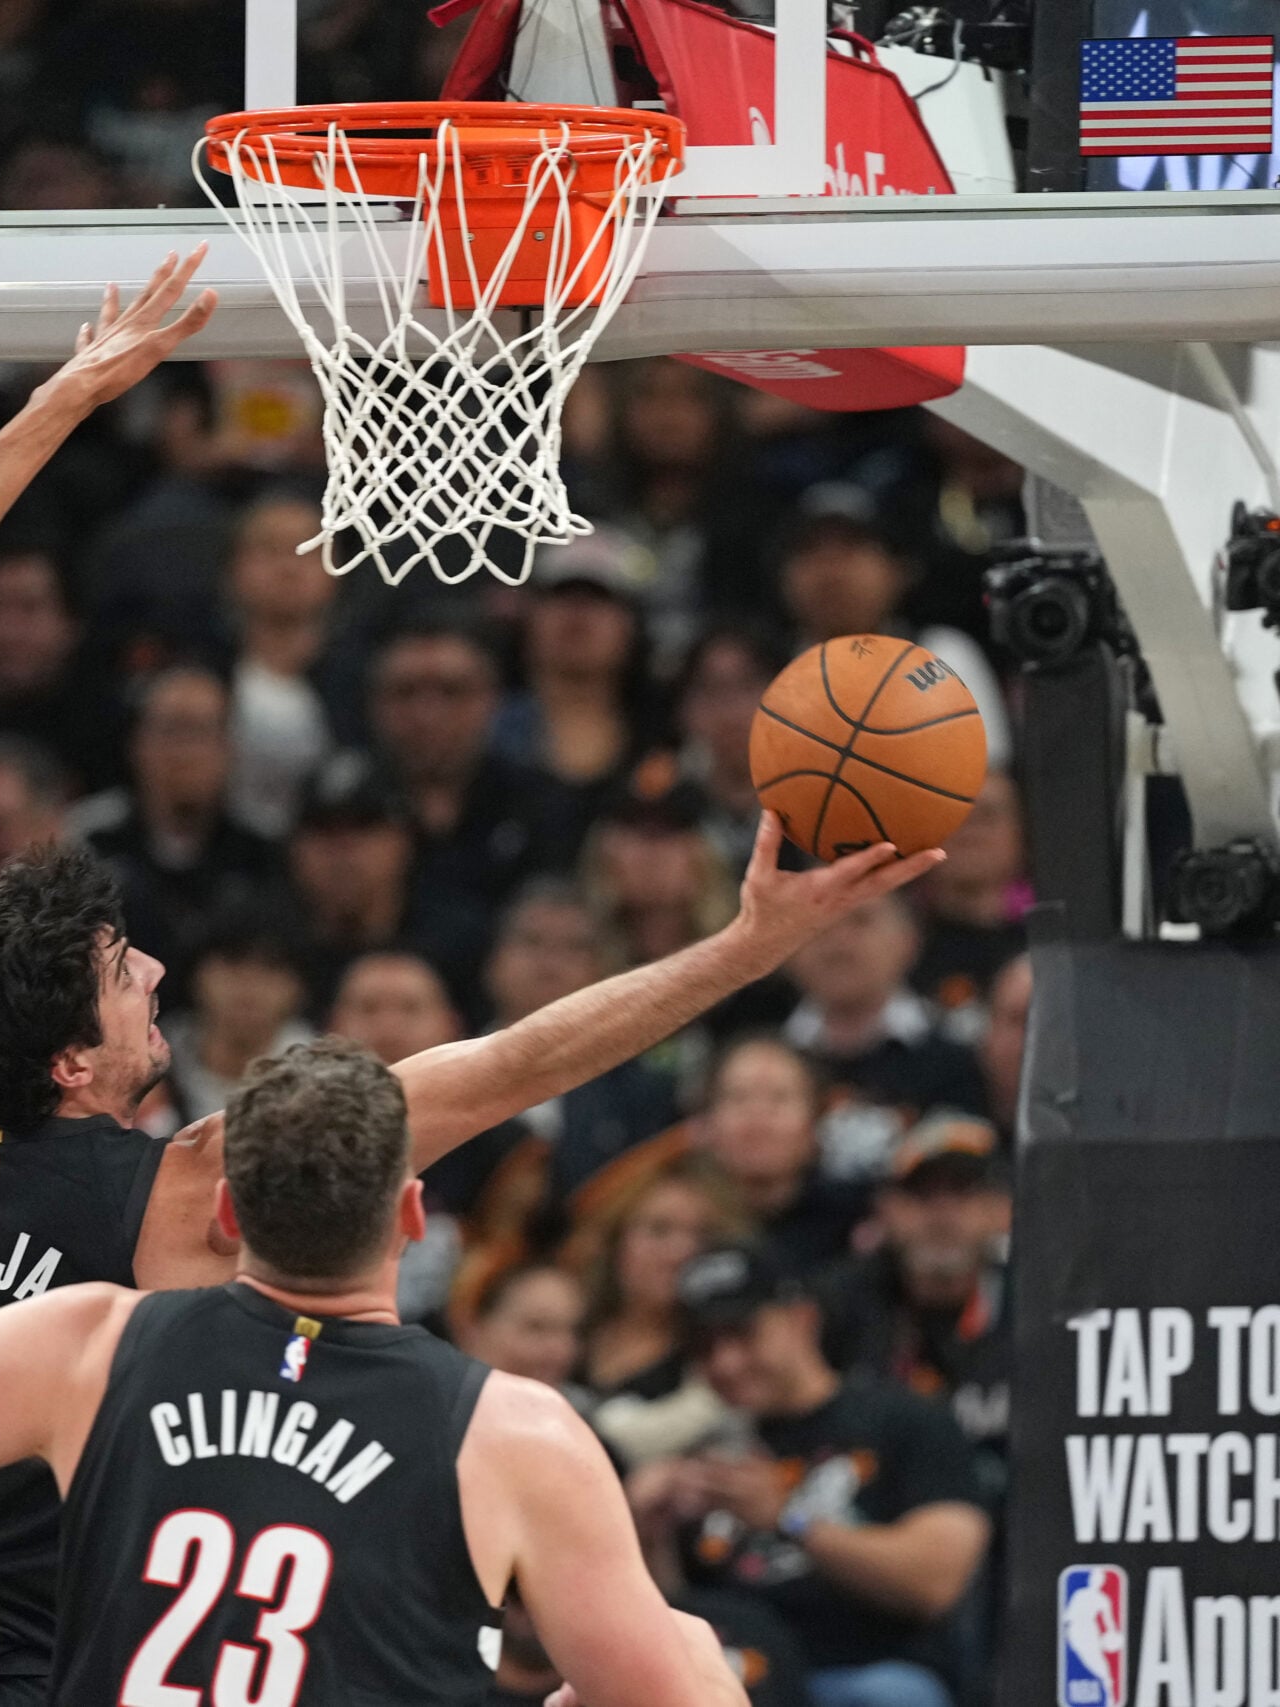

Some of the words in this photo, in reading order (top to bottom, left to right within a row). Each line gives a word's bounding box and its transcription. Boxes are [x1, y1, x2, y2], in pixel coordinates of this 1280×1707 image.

[1066, 1307, 1194, 1417] TAP
[1207, 1304, 1280, 1416] TO
[150, 1389, 395, 1503] CLINGAN
[118, 1507, 334, 1707] 23
